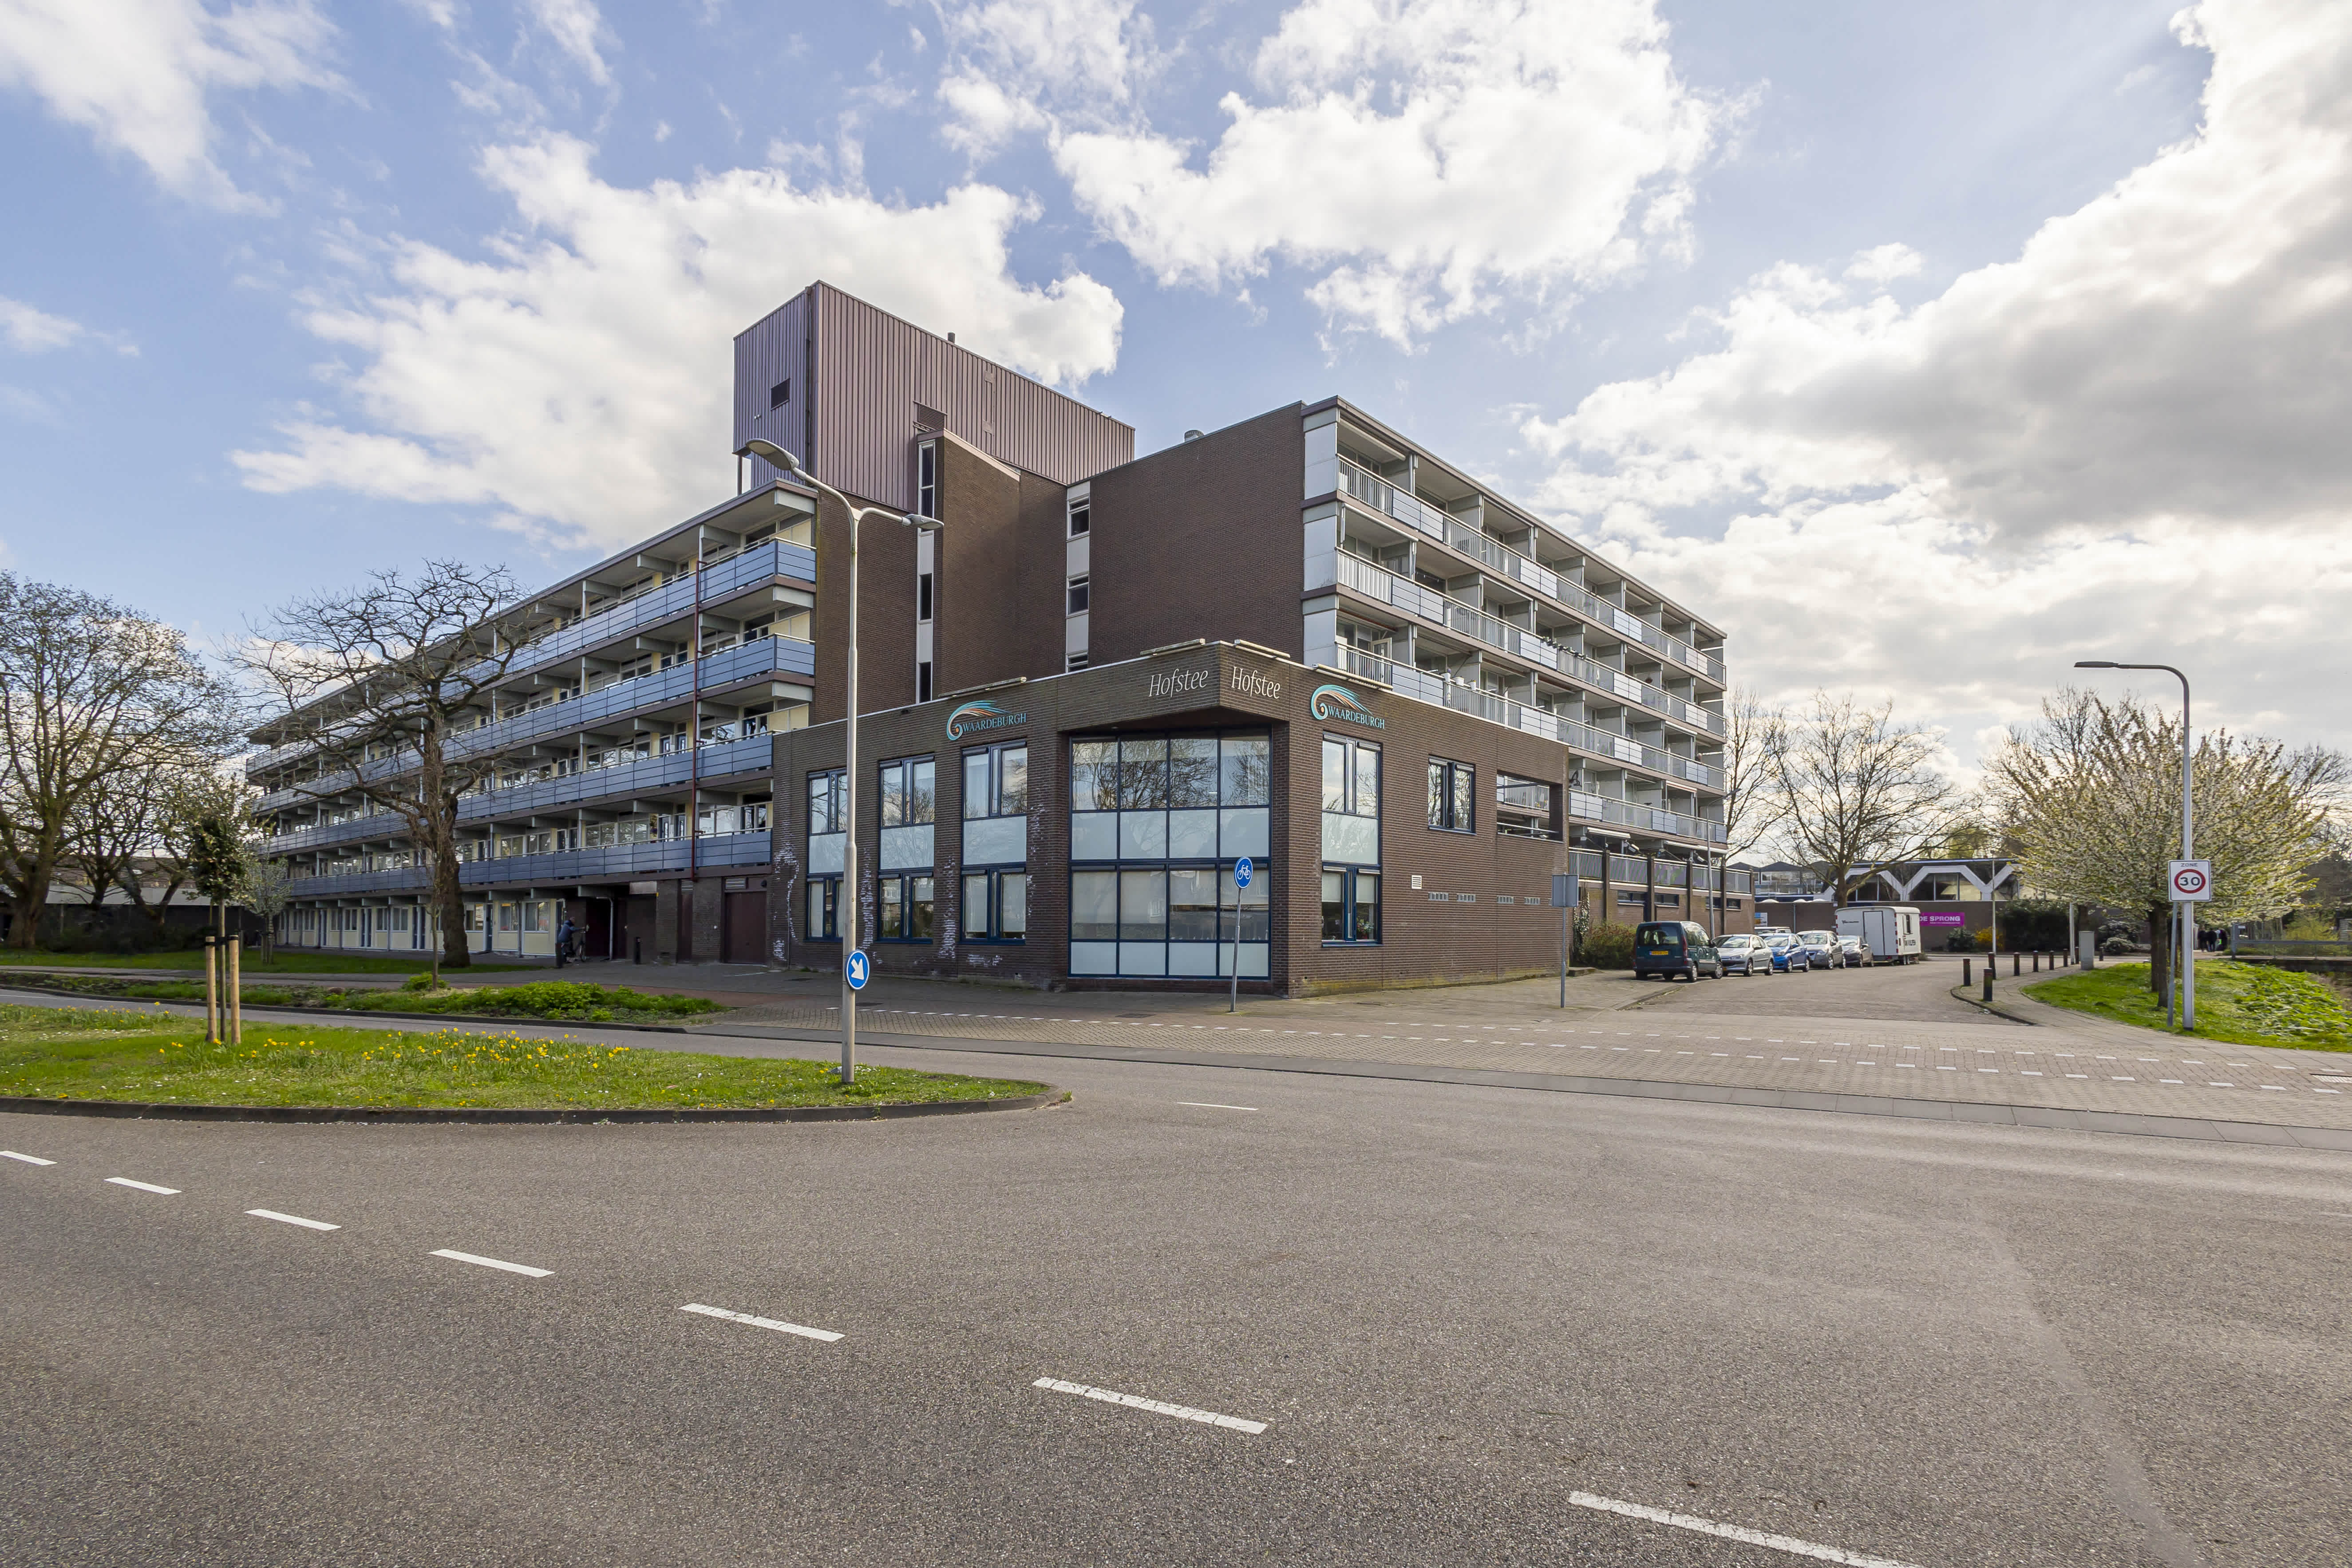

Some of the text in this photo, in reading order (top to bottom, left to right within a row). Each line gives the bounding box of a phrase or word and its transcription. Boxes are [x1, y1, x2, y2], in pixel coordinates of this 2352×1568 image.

[1148, 668, 1208, 698] Hofstee
[1231, 666, 1281, 699] Hofstee
[963, 713, 1027, 732] WAARDEBURGH
[1328, 705, 1385, 729] WAARDEBURGH
[2180, 877, 2200, 886] 30
